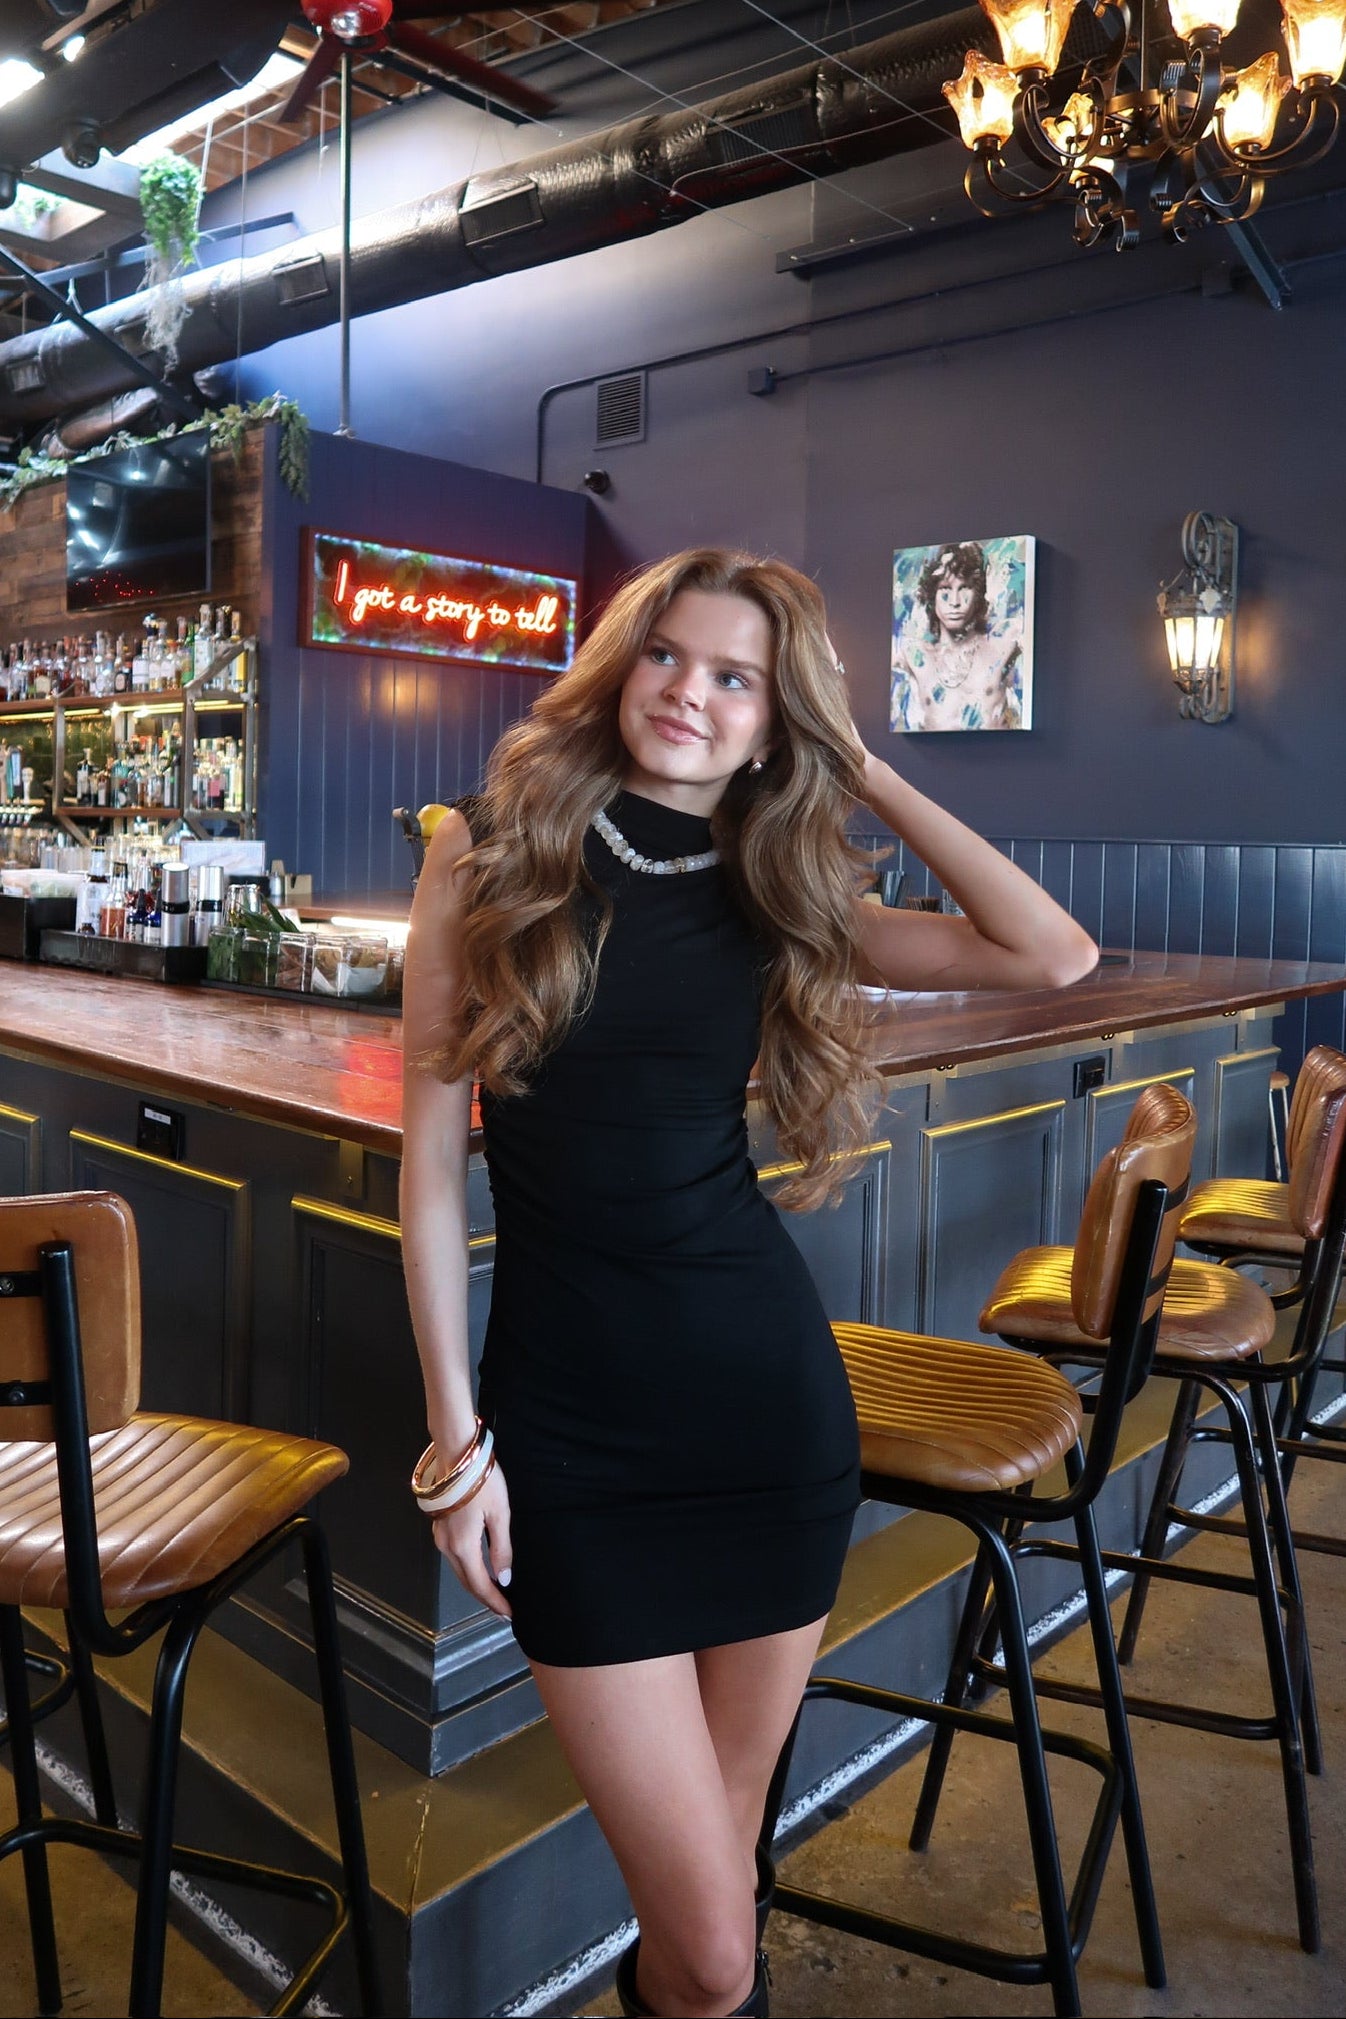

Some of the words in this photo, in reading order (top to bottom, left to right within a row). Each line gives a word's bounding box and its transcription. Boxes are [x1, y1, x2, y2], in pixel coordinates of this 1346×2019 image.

[335, 561, 350, 603] I
[352, 586, 396, 623] got
[399, 595, 423, 614] a
[425, 597, 485, 641] story
[487, 602, 511, 625] to
[514, 596, 559, 634] tell
